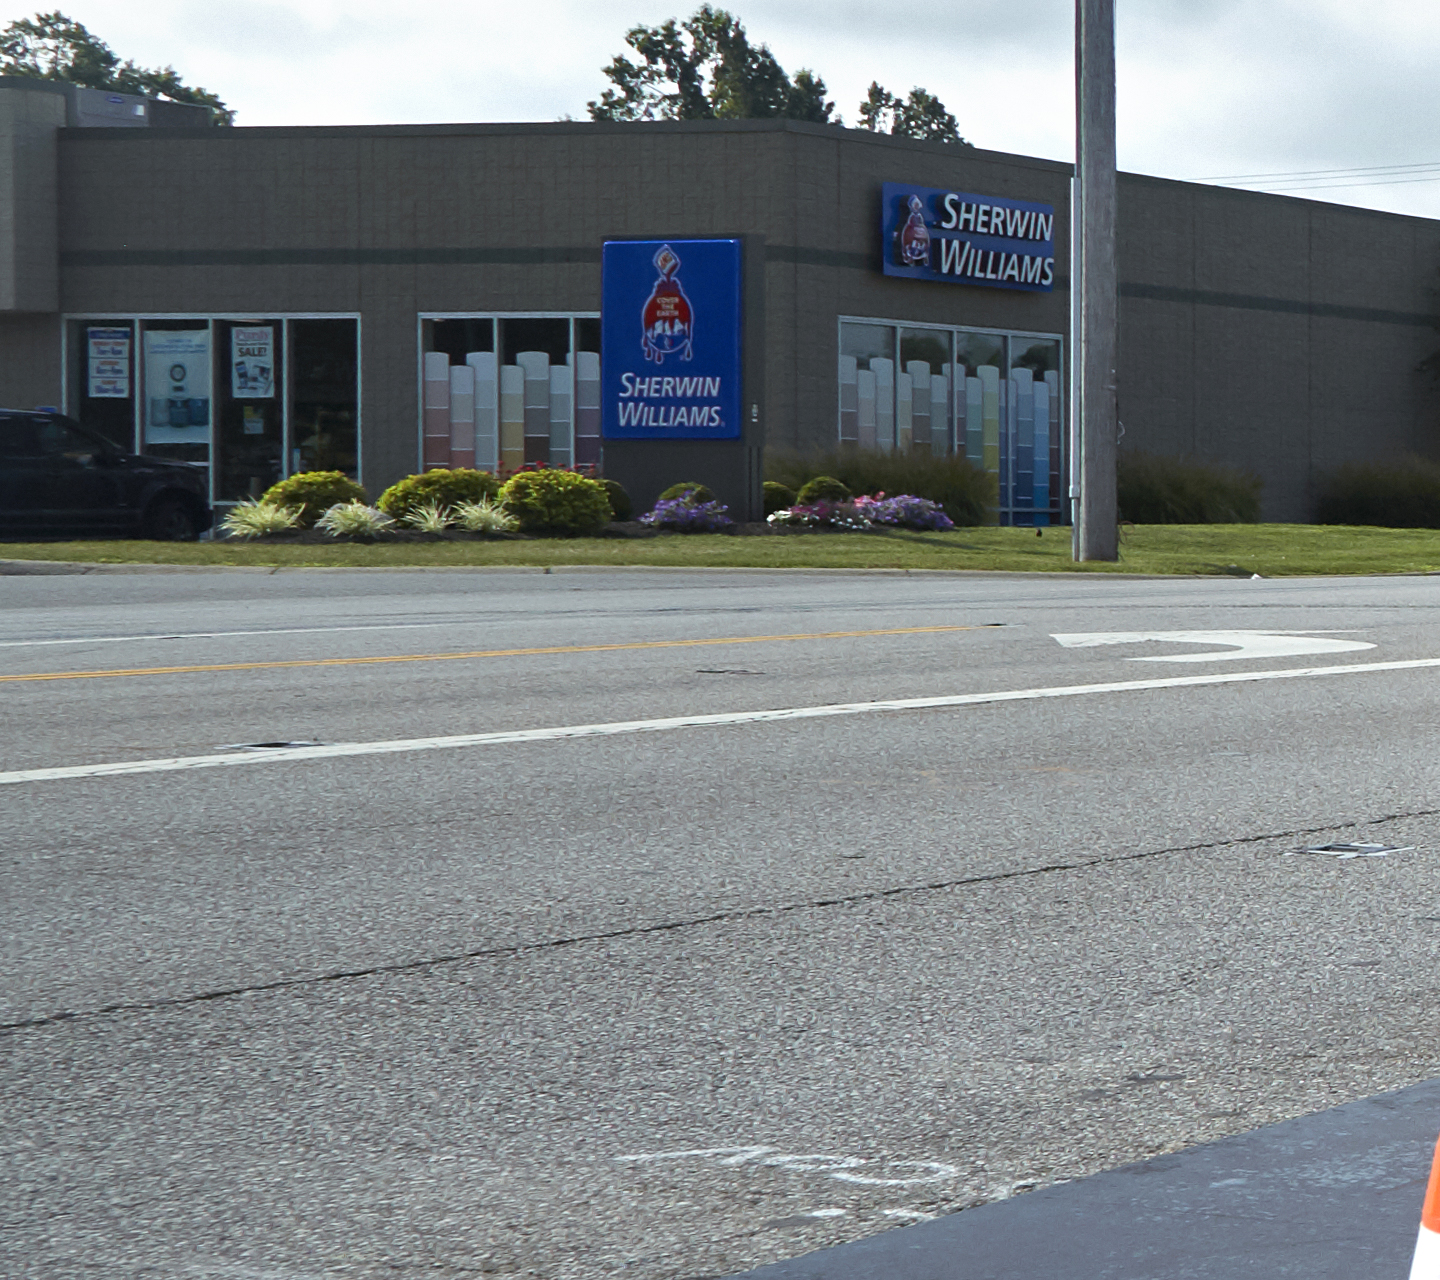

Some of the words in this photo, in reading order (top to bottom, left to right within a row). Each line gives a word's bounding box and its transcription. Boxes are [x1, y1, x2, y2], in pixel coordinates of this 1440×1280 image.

[942, 194, 1053, 241] SHERWIN
[941, 238, 1055, 286] WILLIAMS
[619, 372, 721, 397] SHERWIN
[618, 402, 722, 426] WILLIAMS
